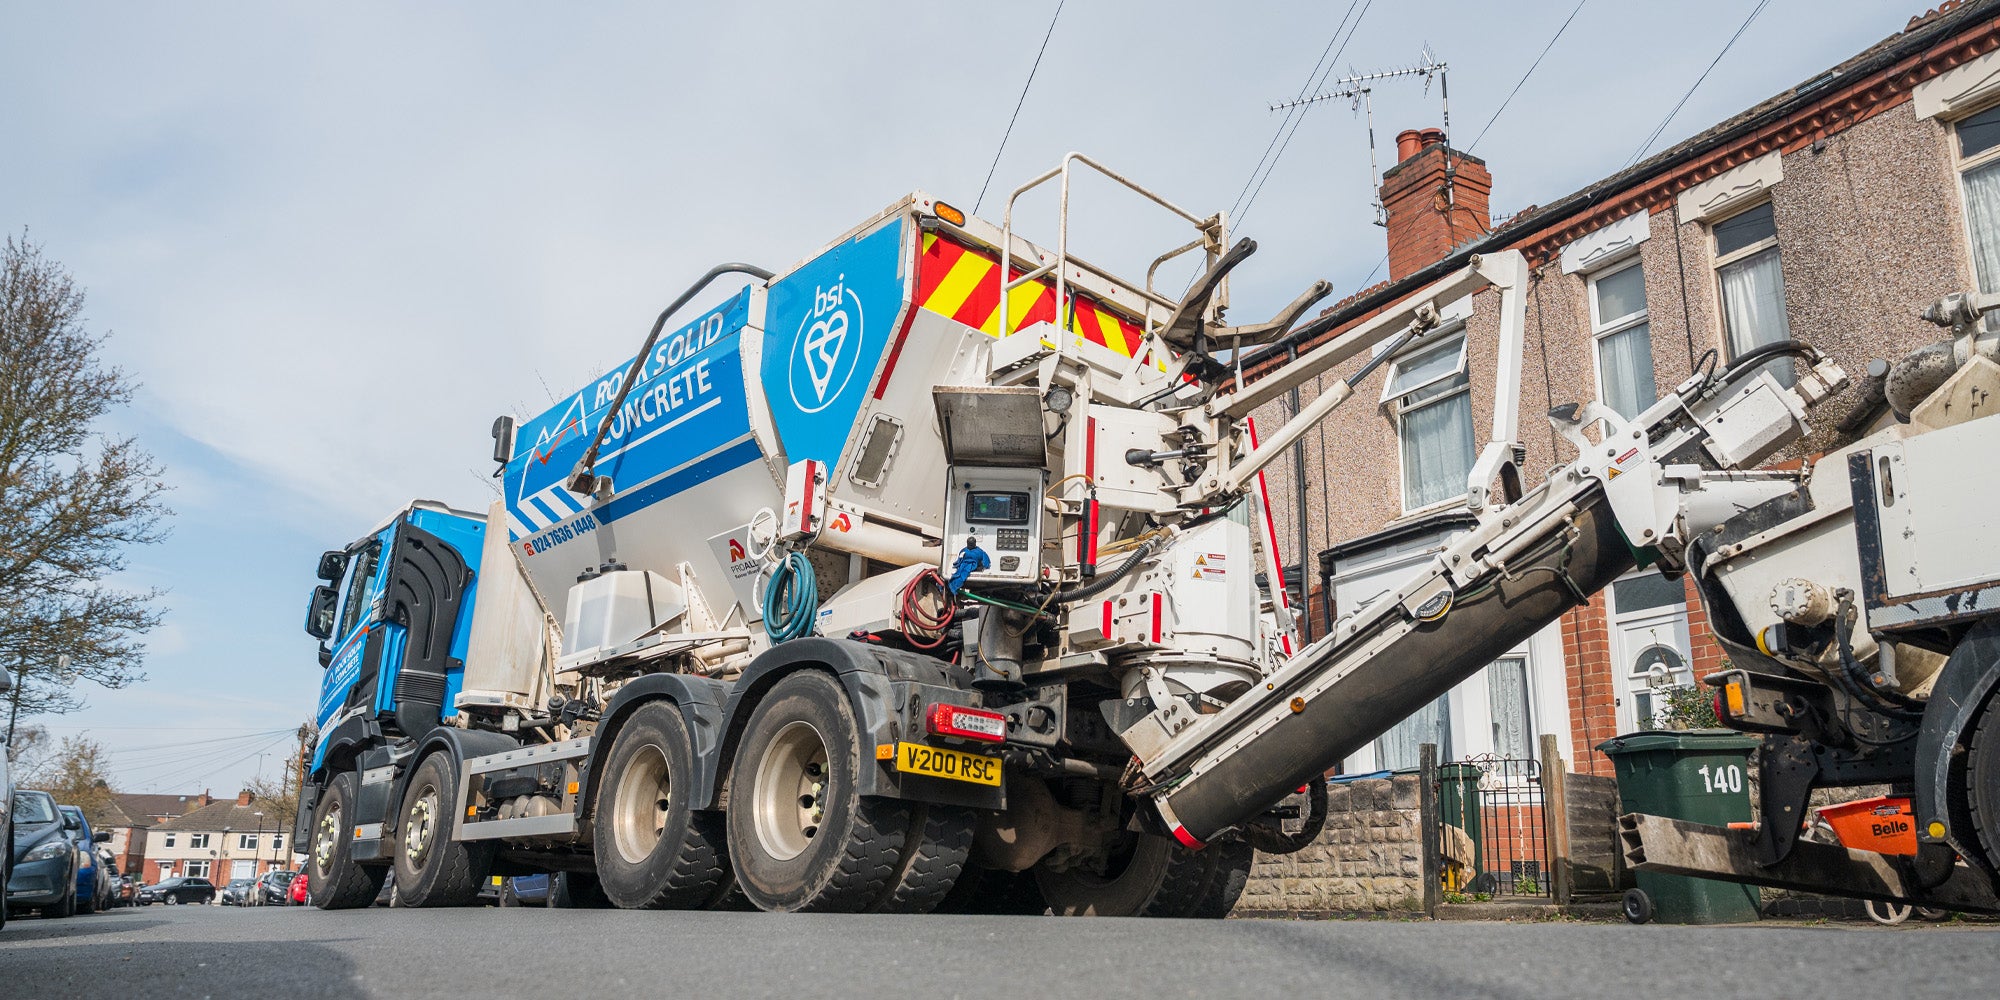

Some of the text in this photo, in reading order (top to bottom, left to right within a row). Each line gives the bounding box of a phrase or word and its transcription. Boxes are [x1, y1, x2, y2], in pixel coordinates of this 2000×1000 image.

[814, 273, 844, 318] bsi
[653, 312, 723, 376] SOLID
[531, 514, 596, 553] 024 7636 1448
[730, 560, 759, 573] PROALL
[908, 747, 994, 780] V200 RSC
[1698, 764, 1742, 793] 140
[1871, 820, 1908, 836] Belle
